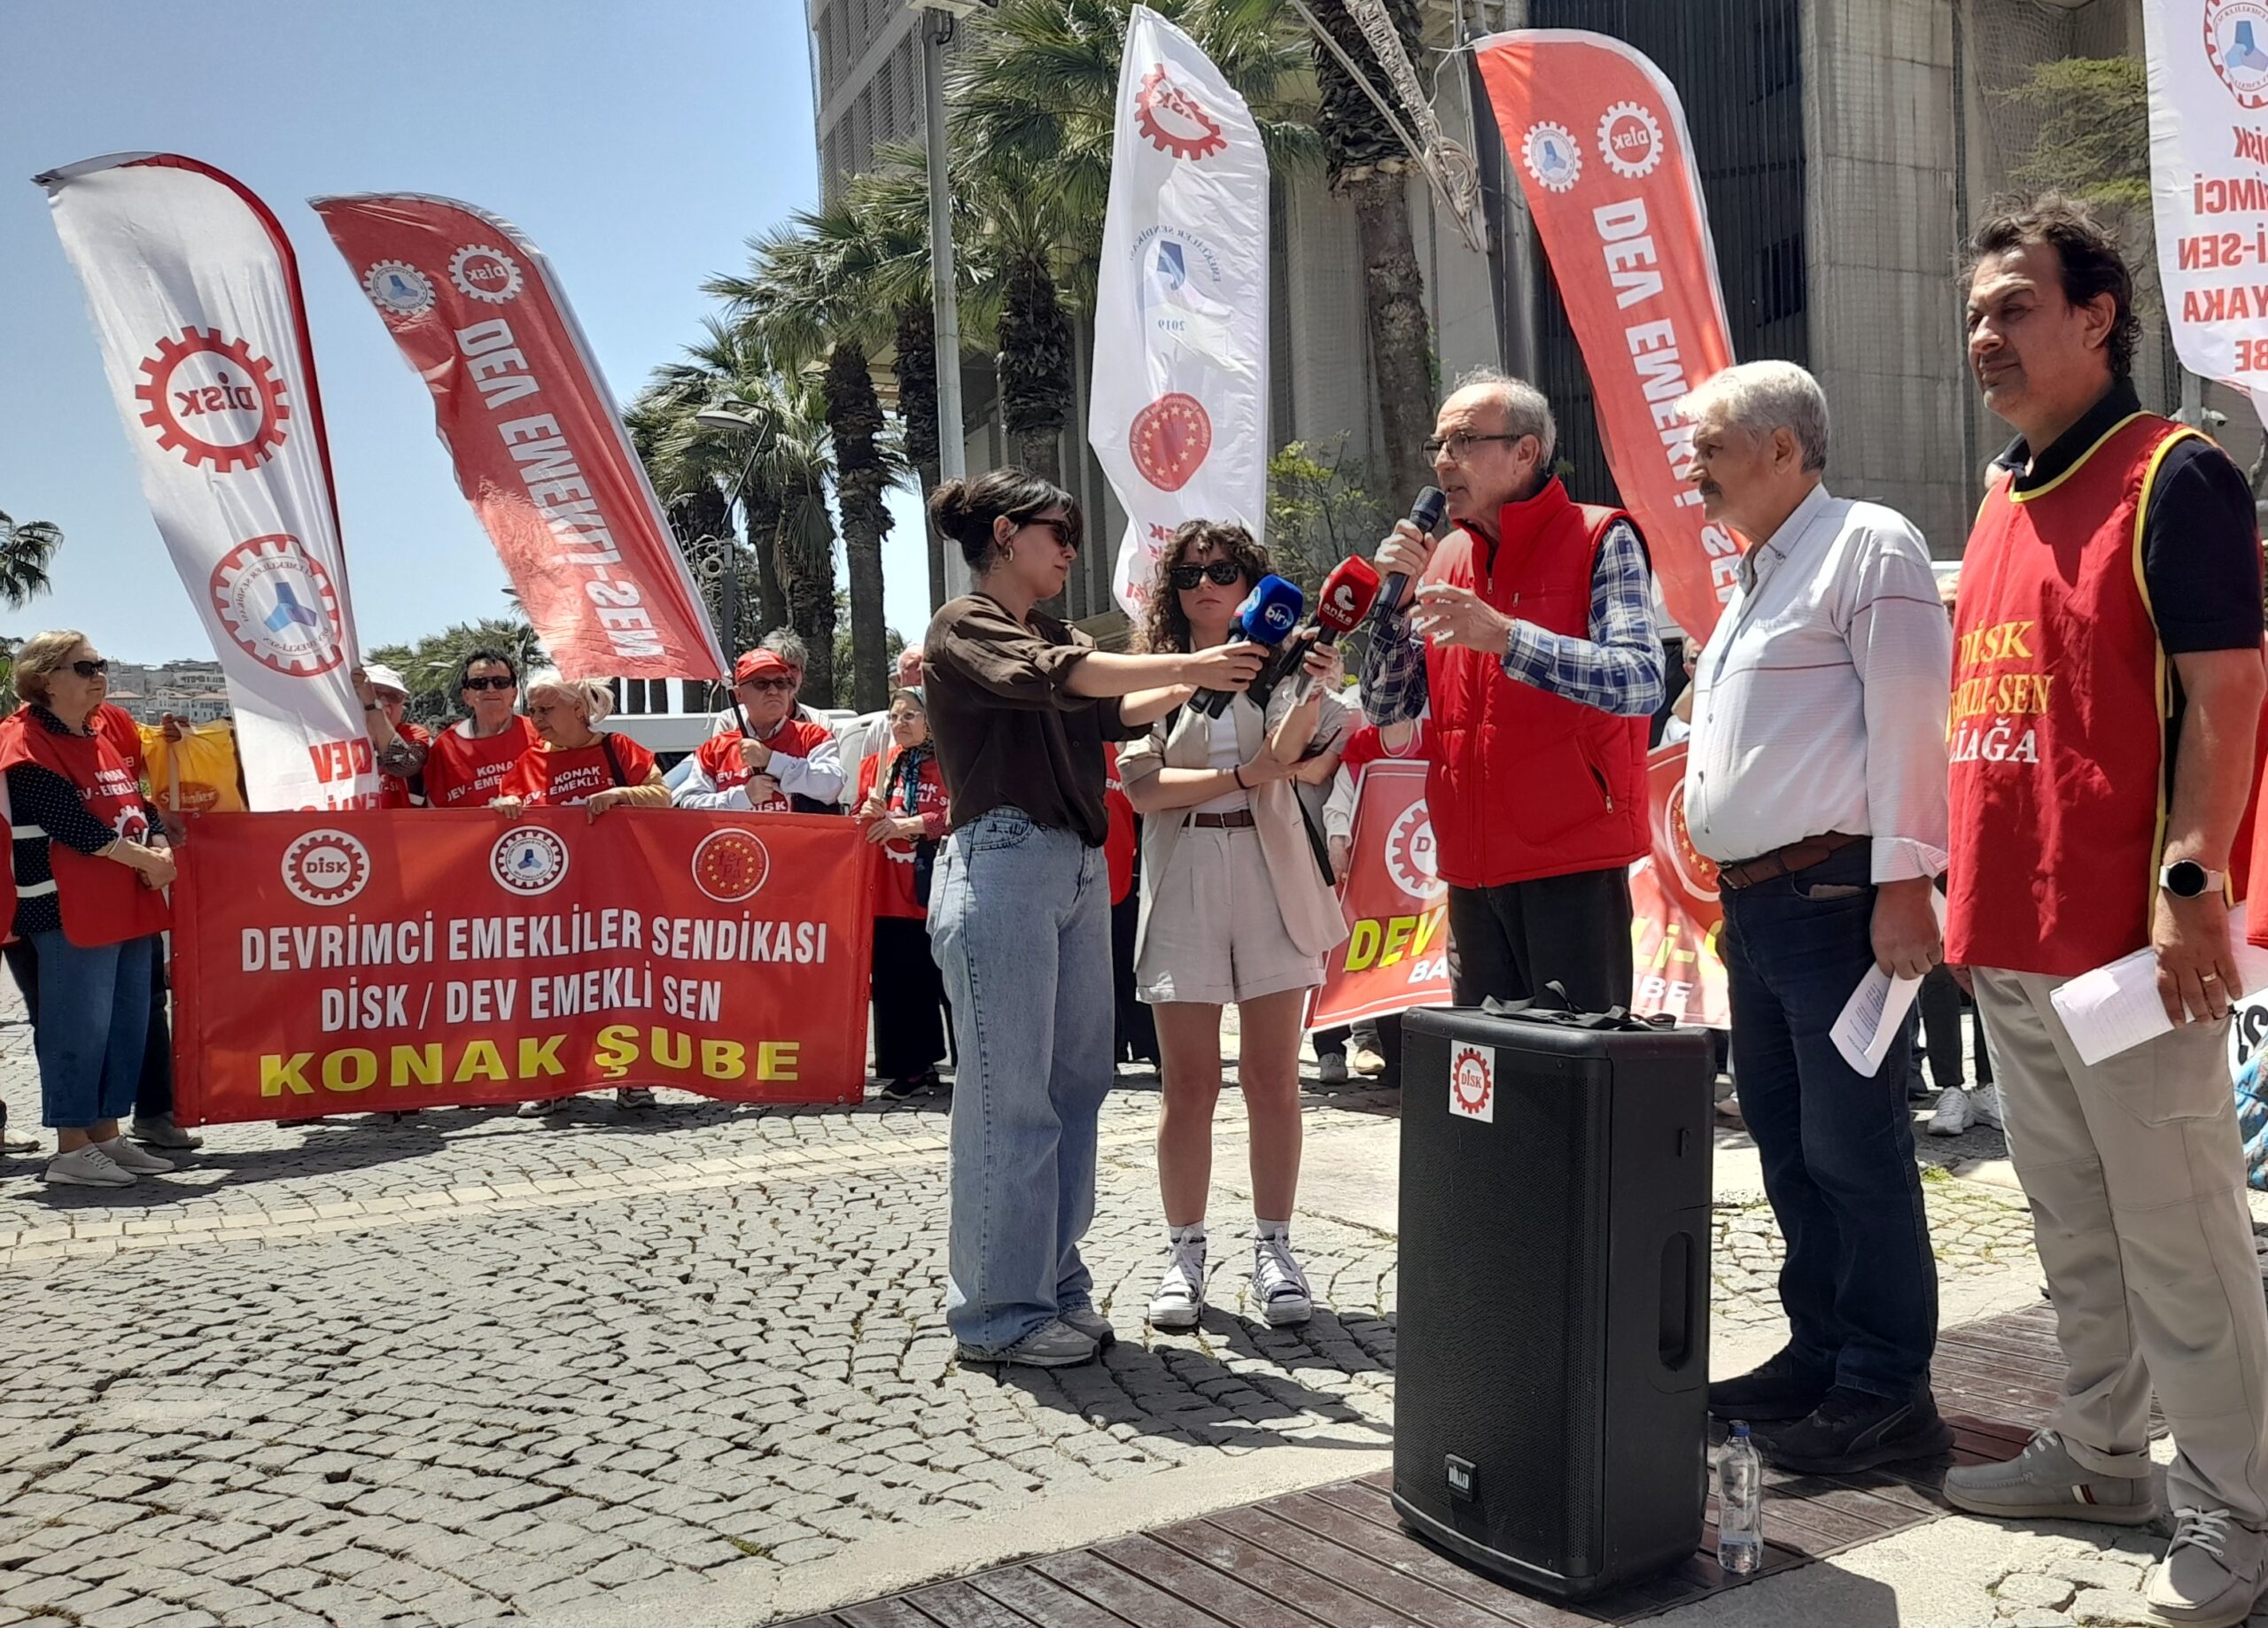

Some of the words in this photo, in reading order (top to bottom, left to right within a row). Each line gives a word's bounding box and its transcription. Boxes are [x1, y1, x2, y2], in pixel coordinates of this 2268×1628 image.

[477, 760, 515, 778] KONA
[554, 765, 602, 785] KONAK
[306, 857, 348, 873] DİSK
[241, 910, 434, 972] DEVRİMCİ
[448, 902, 641, 961] EMEKLİLER
[651, 910, 827, 965] SENDİKASI
[1343, 904, 1447, 973] DEV
[1407, 958, 1447, 984] BA
[321, 975, 410, 1033] DİSK
[445, 978, 517, 1025] DEV
[530, 960, 653, 1019] EMEKLİ
[662, 980, 722, 1023] SEN
[259, 1033, 569, 1098] KONAK
[594, 1024, 801, 1082] ŞUBE
[1461, 1069, 1482, 1089] DİSK
